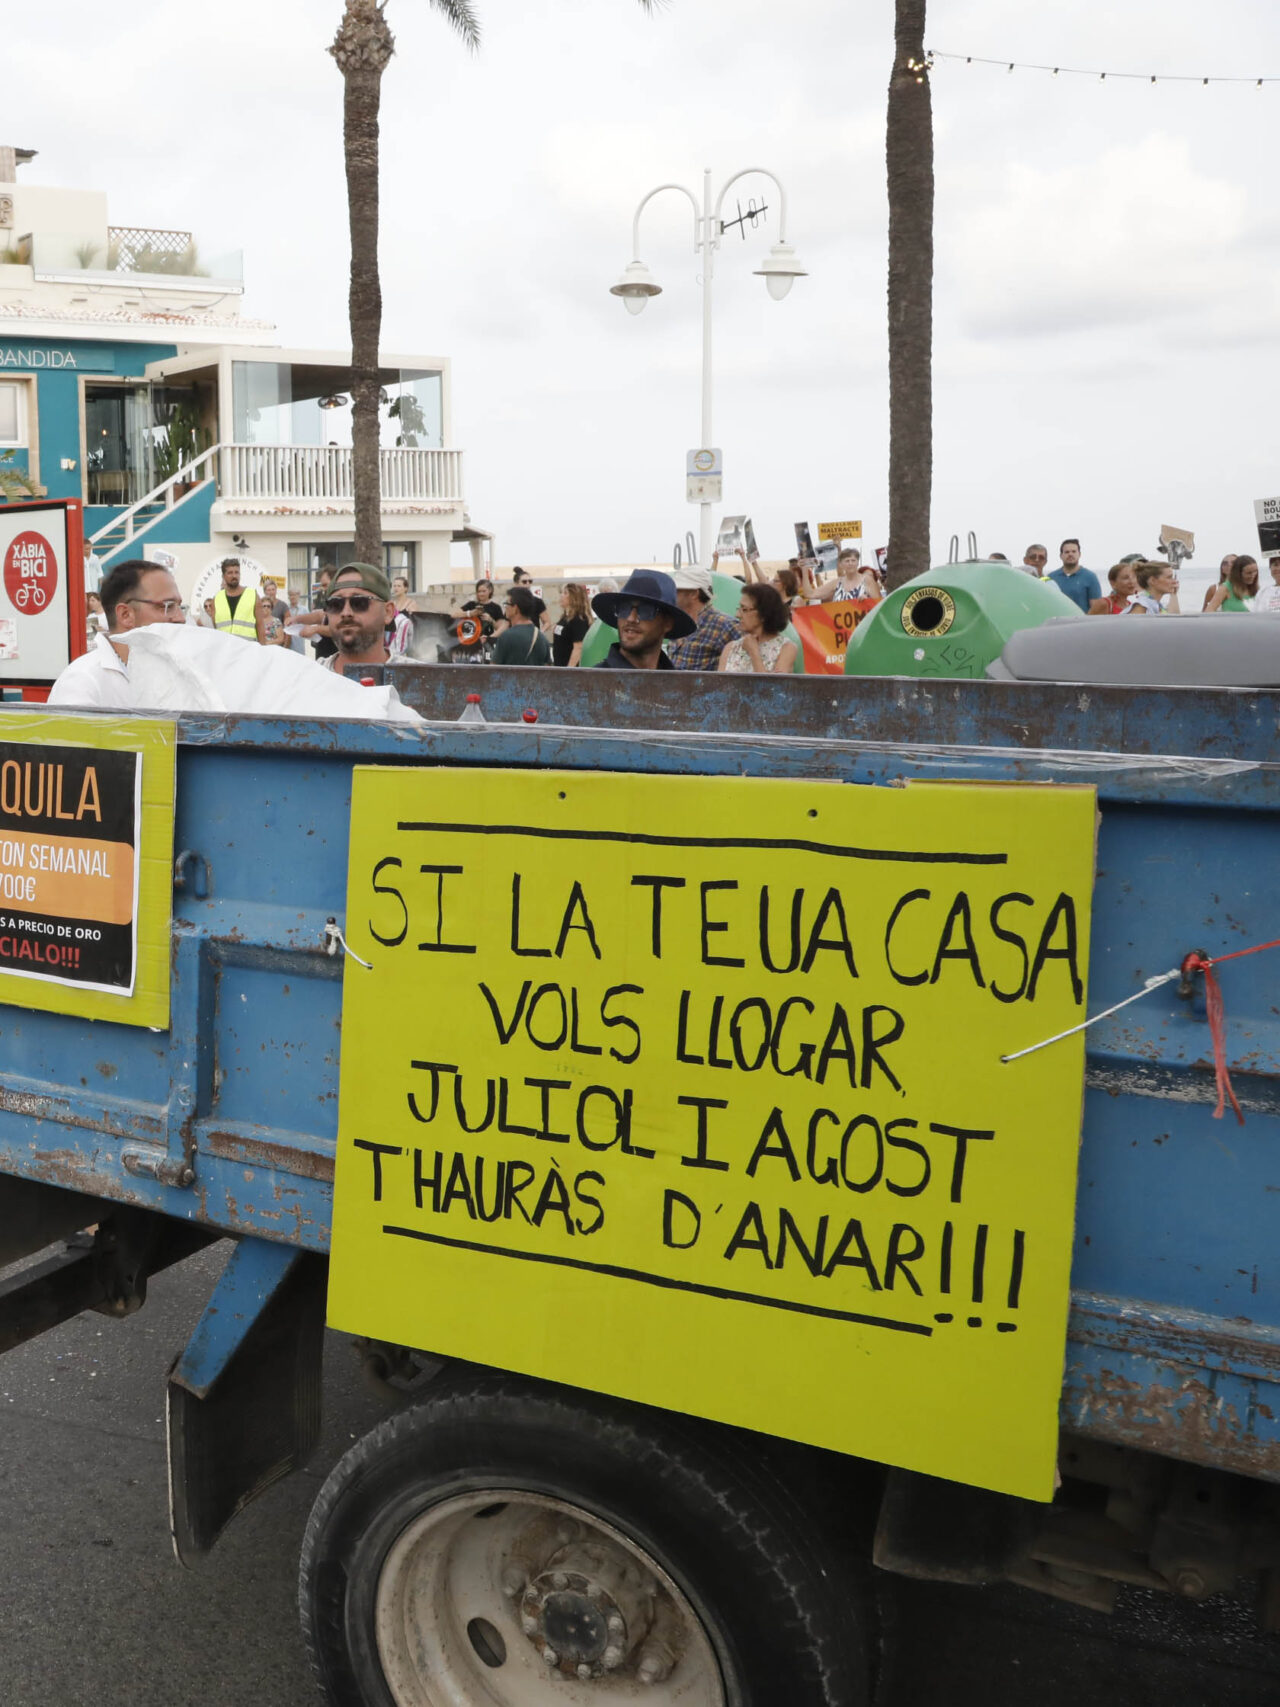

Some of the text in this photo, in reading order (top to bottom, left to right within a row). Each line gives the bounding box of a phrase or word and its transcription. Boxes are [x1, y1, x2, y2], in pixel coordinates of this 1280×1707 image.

[13, 541, 47, 559] XÀBIA
[13, 558, 47, 578] EN BICI
[937, 591, 945, 600] DE
[29, 843, 111, 878] SEMANAL
[8, 918, 16, 929] A
[18, 920, 55, 936] PRECIO
[57, 925, 72, 938] DE
[74, 928, 102, 941] ORO
[369, 856, 1084, 1005] SI LA TEUA CASA
[478, 981, 644, 1065] VOLS
[407, 1060, 995, 1203] JULIOL I AGOST
